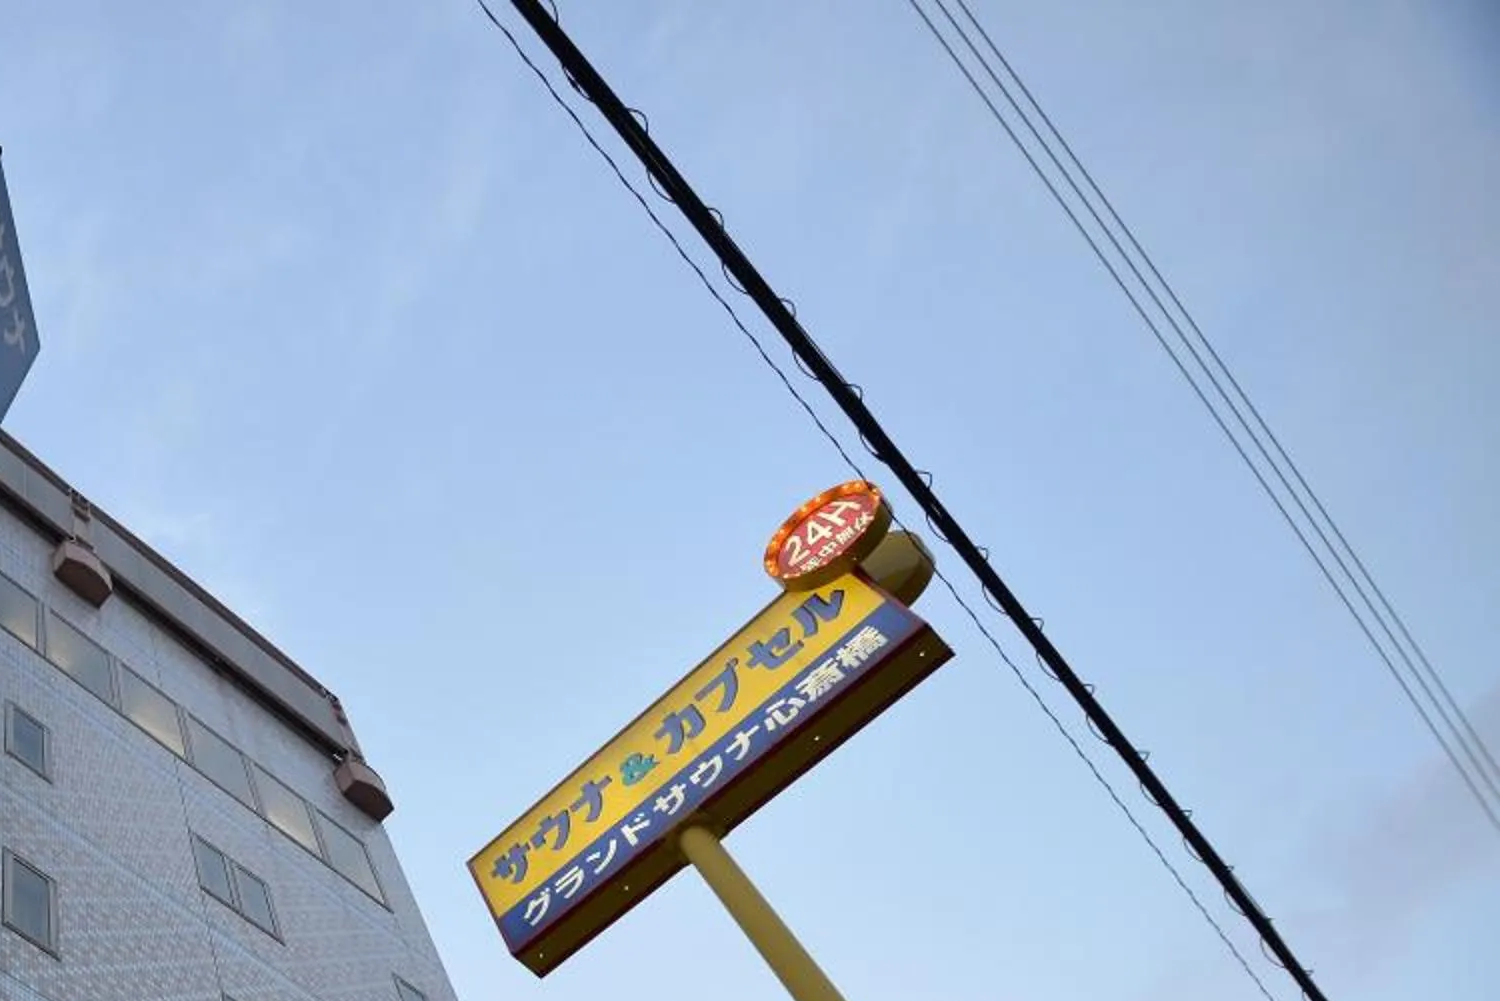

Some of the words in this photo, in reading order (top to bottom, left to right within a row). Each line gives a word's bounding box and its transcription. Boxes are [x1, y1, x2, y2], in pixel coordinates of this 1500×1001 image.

[785, 501, 862, 567] 24H
[524, 625, 890, 926] グランドサウナ心斎橋
